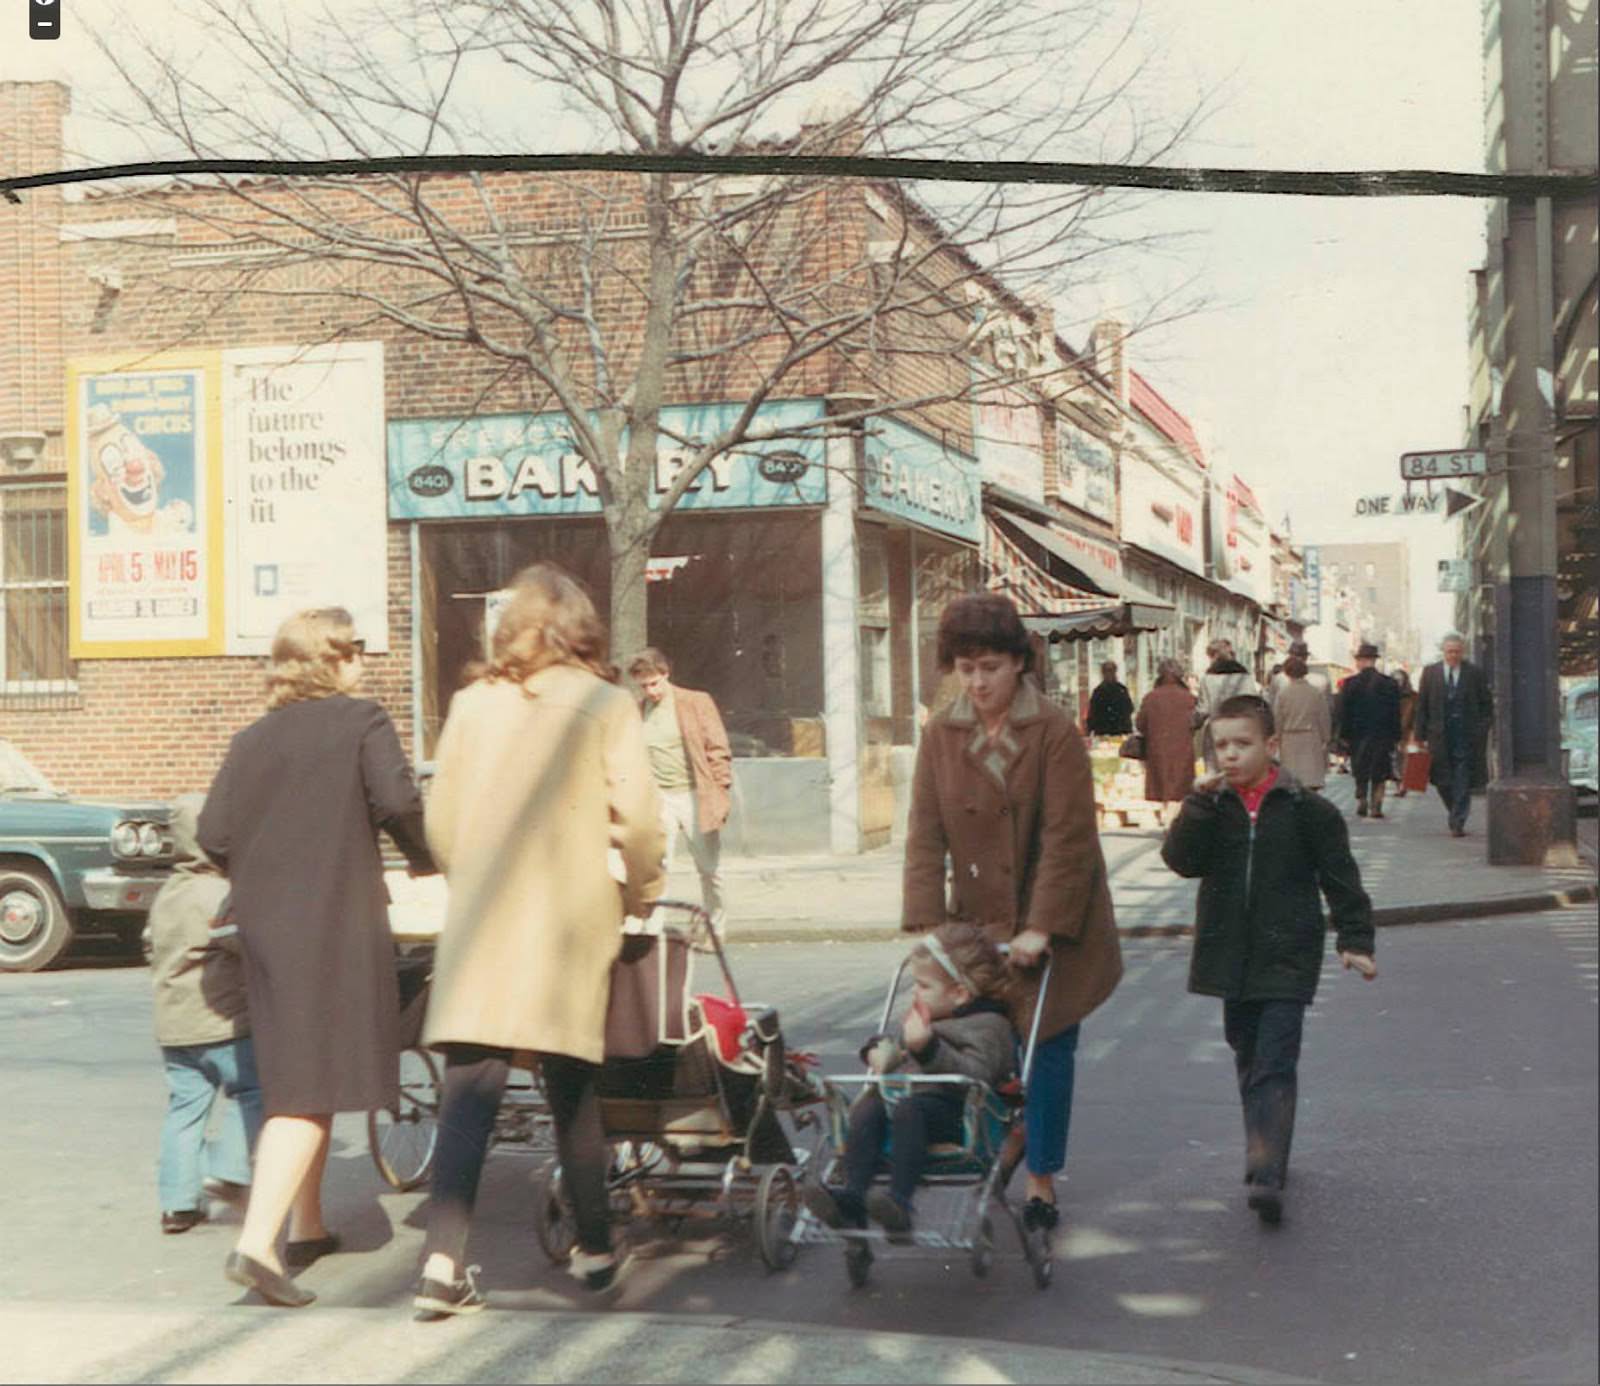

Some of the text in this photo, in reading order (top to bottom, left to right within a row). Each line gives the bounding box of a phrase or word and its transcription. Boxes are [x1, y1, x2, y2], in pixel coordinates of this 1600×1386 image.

[248, 377, 294, 401] The
[248, 406, 324, 433] future
[248, 437, 346, 464] belongs
[465, 449, 738, 501] BAKRY
[1411, 454, 1475, 475] 84 ST
[249, 466, 319, 493] to the
[414, 474, 449, 488] 8401
[249, 498, 276, 523] fit
[1355, 494, 1440, 515] ONE WAY
[131, 552, 143, 582] 5
[180, 549, 197, 581] 15
